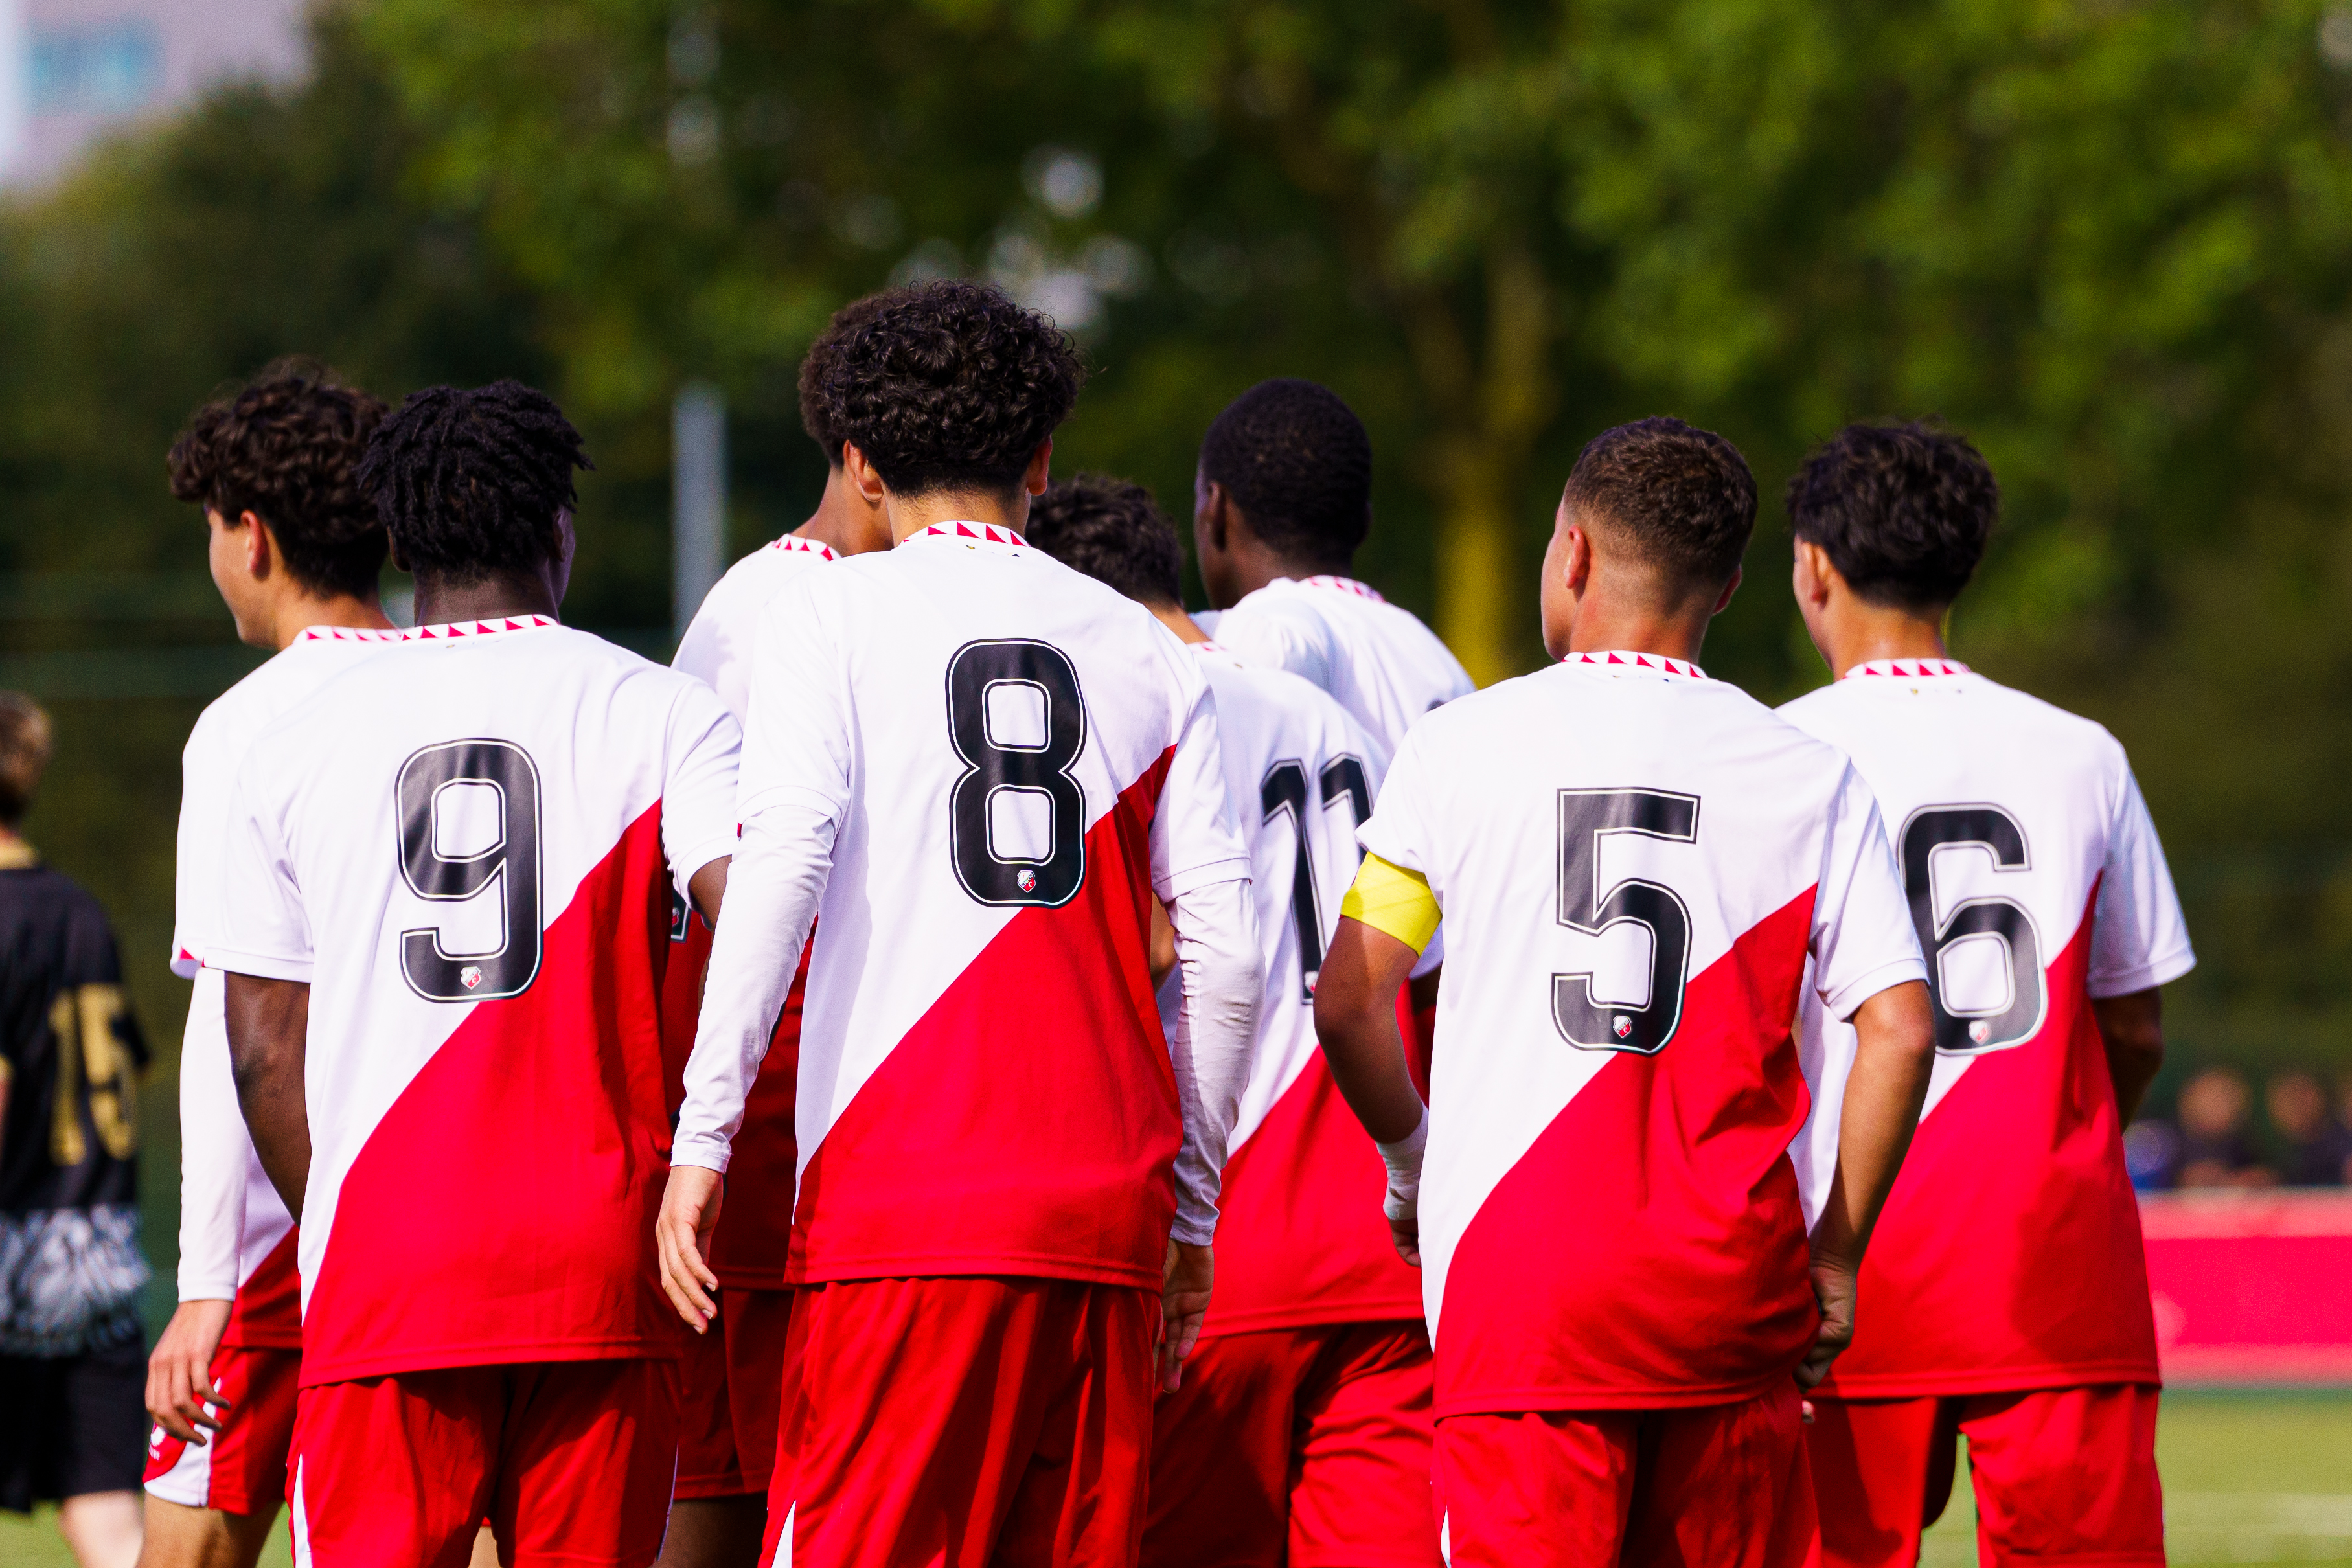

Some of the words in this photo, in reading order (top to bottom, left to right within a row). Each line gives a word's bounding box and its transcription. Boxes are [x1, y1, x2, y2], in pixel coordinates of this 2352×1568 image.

[394, 737, 543, 1003] 9
[946, 639, 1087, 909] 8
[1551, 787, 1701, 1056] 5
[1898, 802, 2048, 1056] 6
